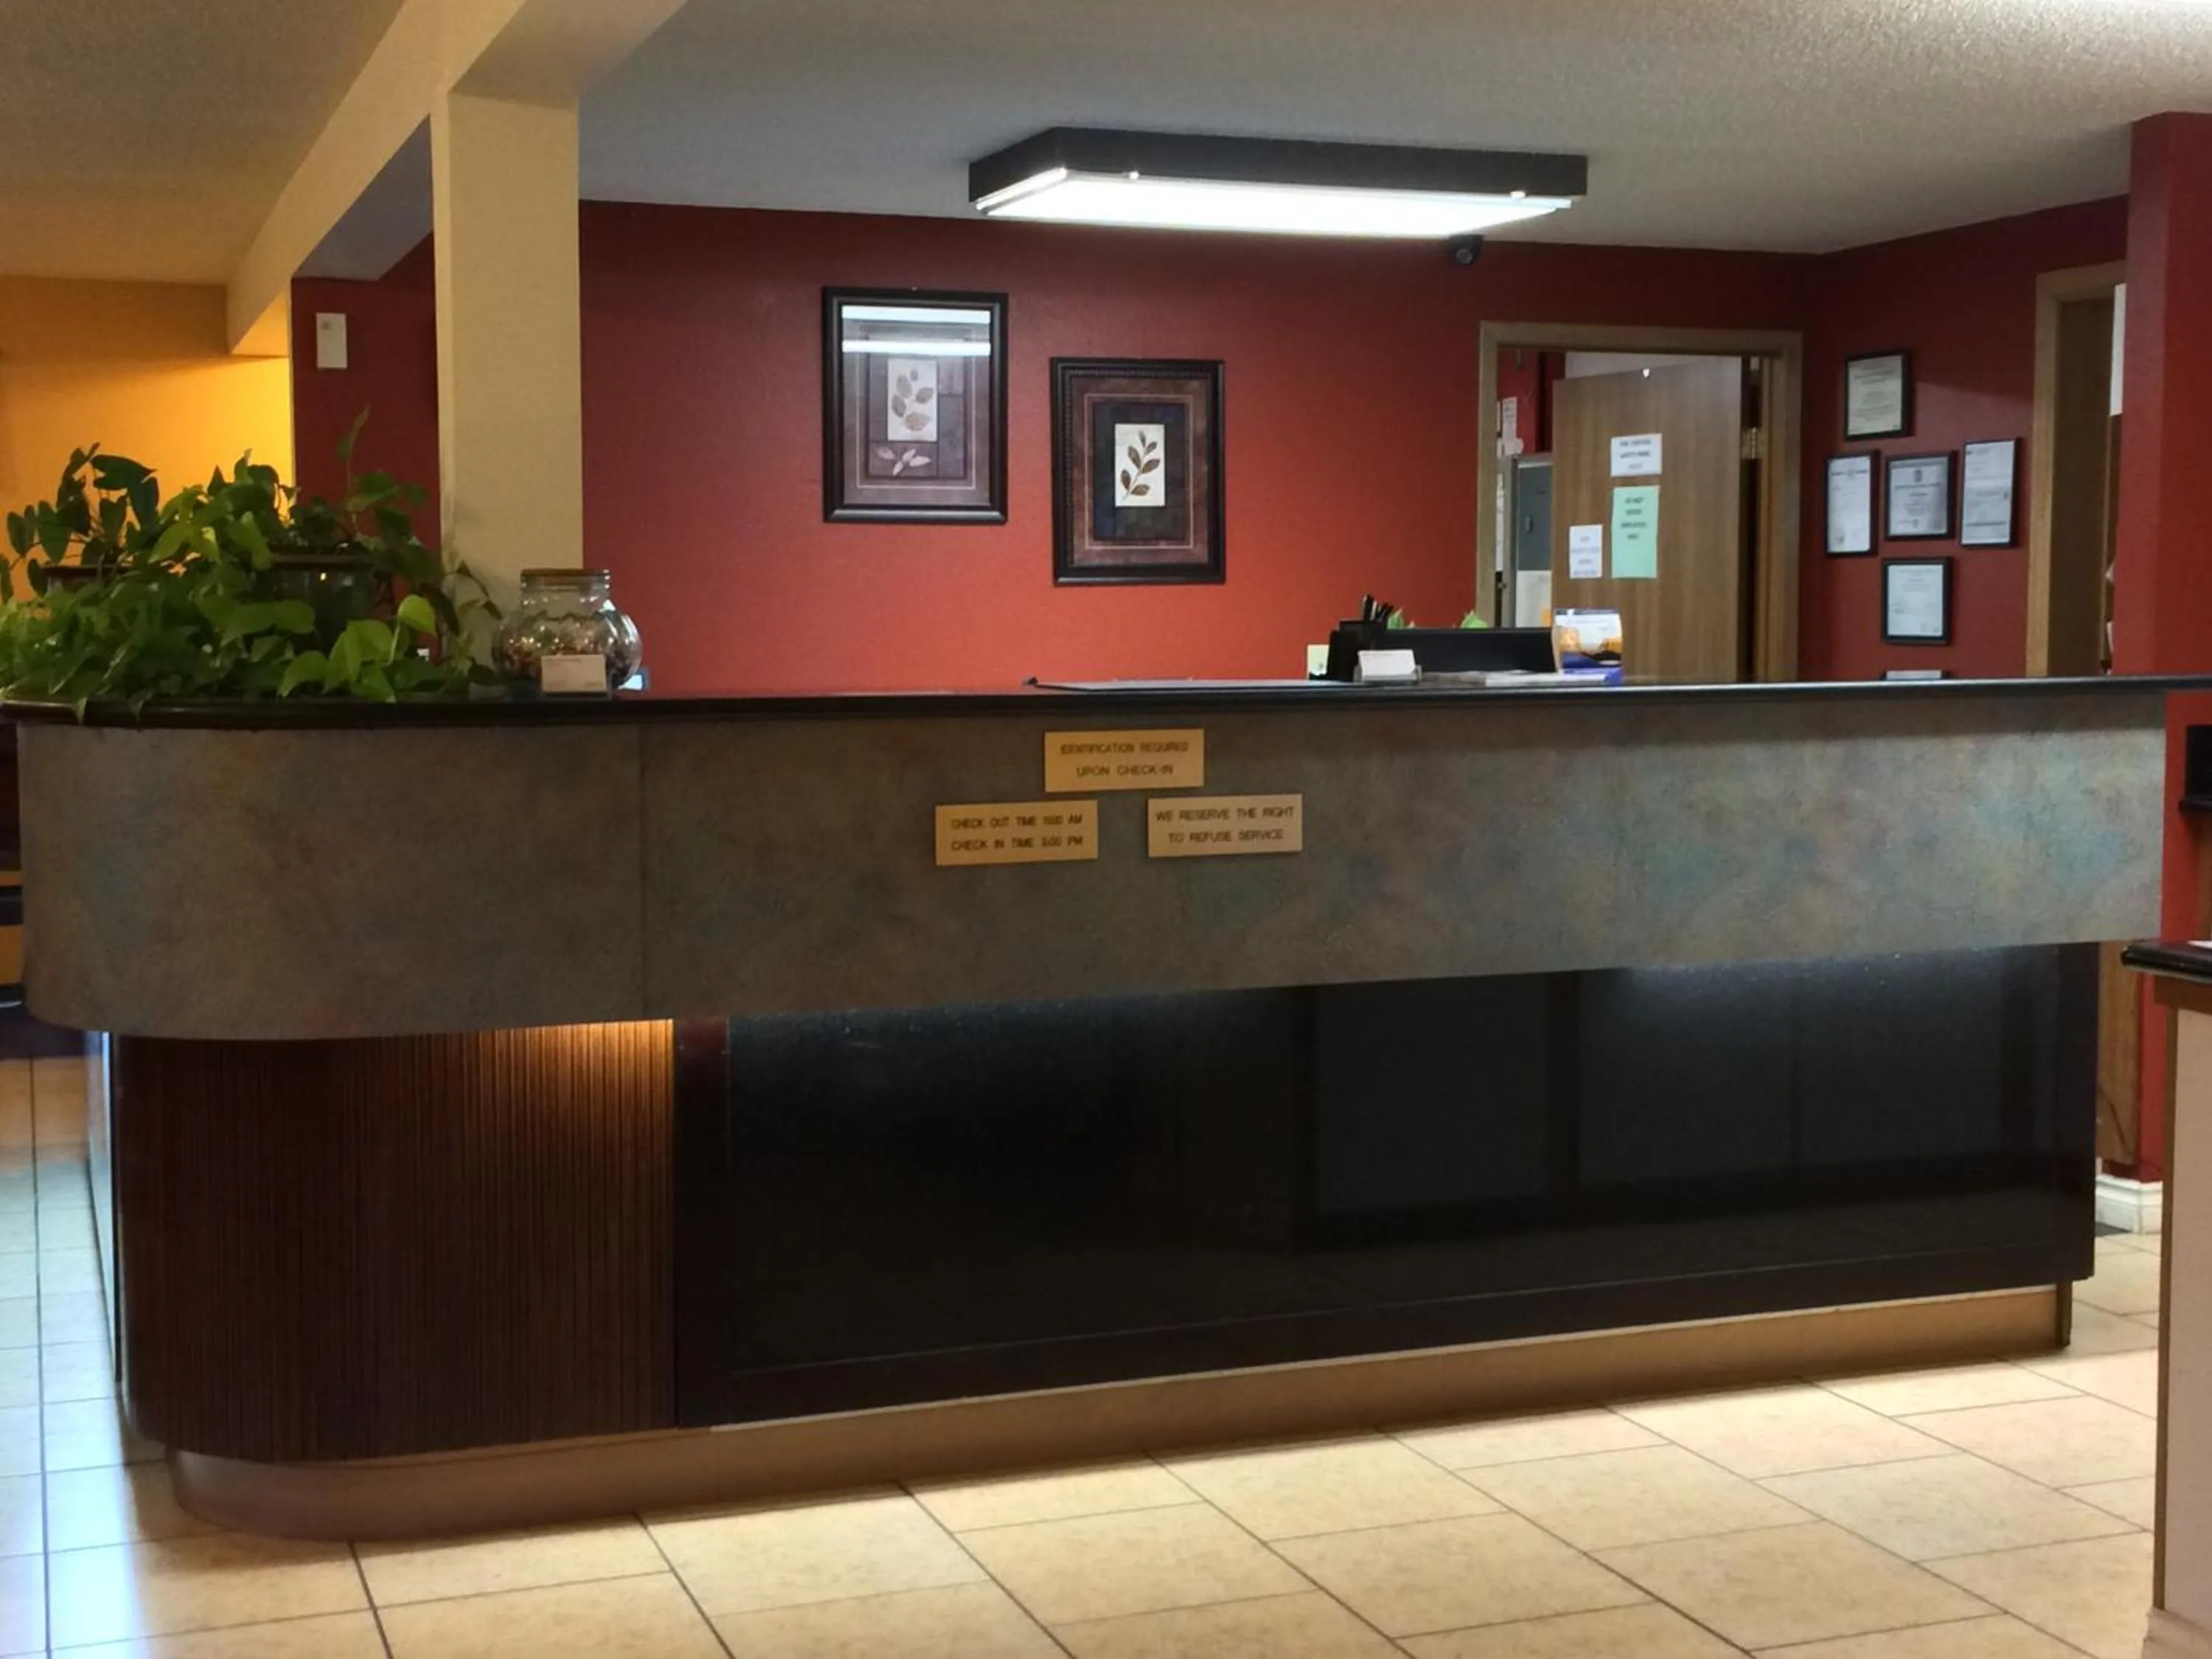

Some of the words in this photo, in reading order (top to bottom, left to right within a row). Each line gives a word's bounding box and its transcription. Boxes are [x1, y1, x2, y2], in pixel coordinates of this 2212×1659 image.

[1077, 765, 1110, 777] UPON
[1117, 764, 1174, 776] CHECK-IN
[1155, 810, 1173, 821] WE
[1178, 808, 1230, 821] RESERVE
[1236, 807, 1257, 818] THE
[1261, 806, 1294, 818] RIGHT
[951, 818, 984, 830] CHECK
[990, 817, 1010, 828] OUT
[1015, 815, 1037, 827] TIME
[1068, 813, 1083, 825] AM
[951, 838, 988, 851] CHECK
[994, 838, 1005, 849] IN
[1012, 837, 1034, 848] TIME
[1067, 835, 1084, 846] PM
[1168, 832, 1184, 844] TO
[1189, 831, 1232, 843] REFUSE
[1238, 829, 1284, 841] SERVICE
